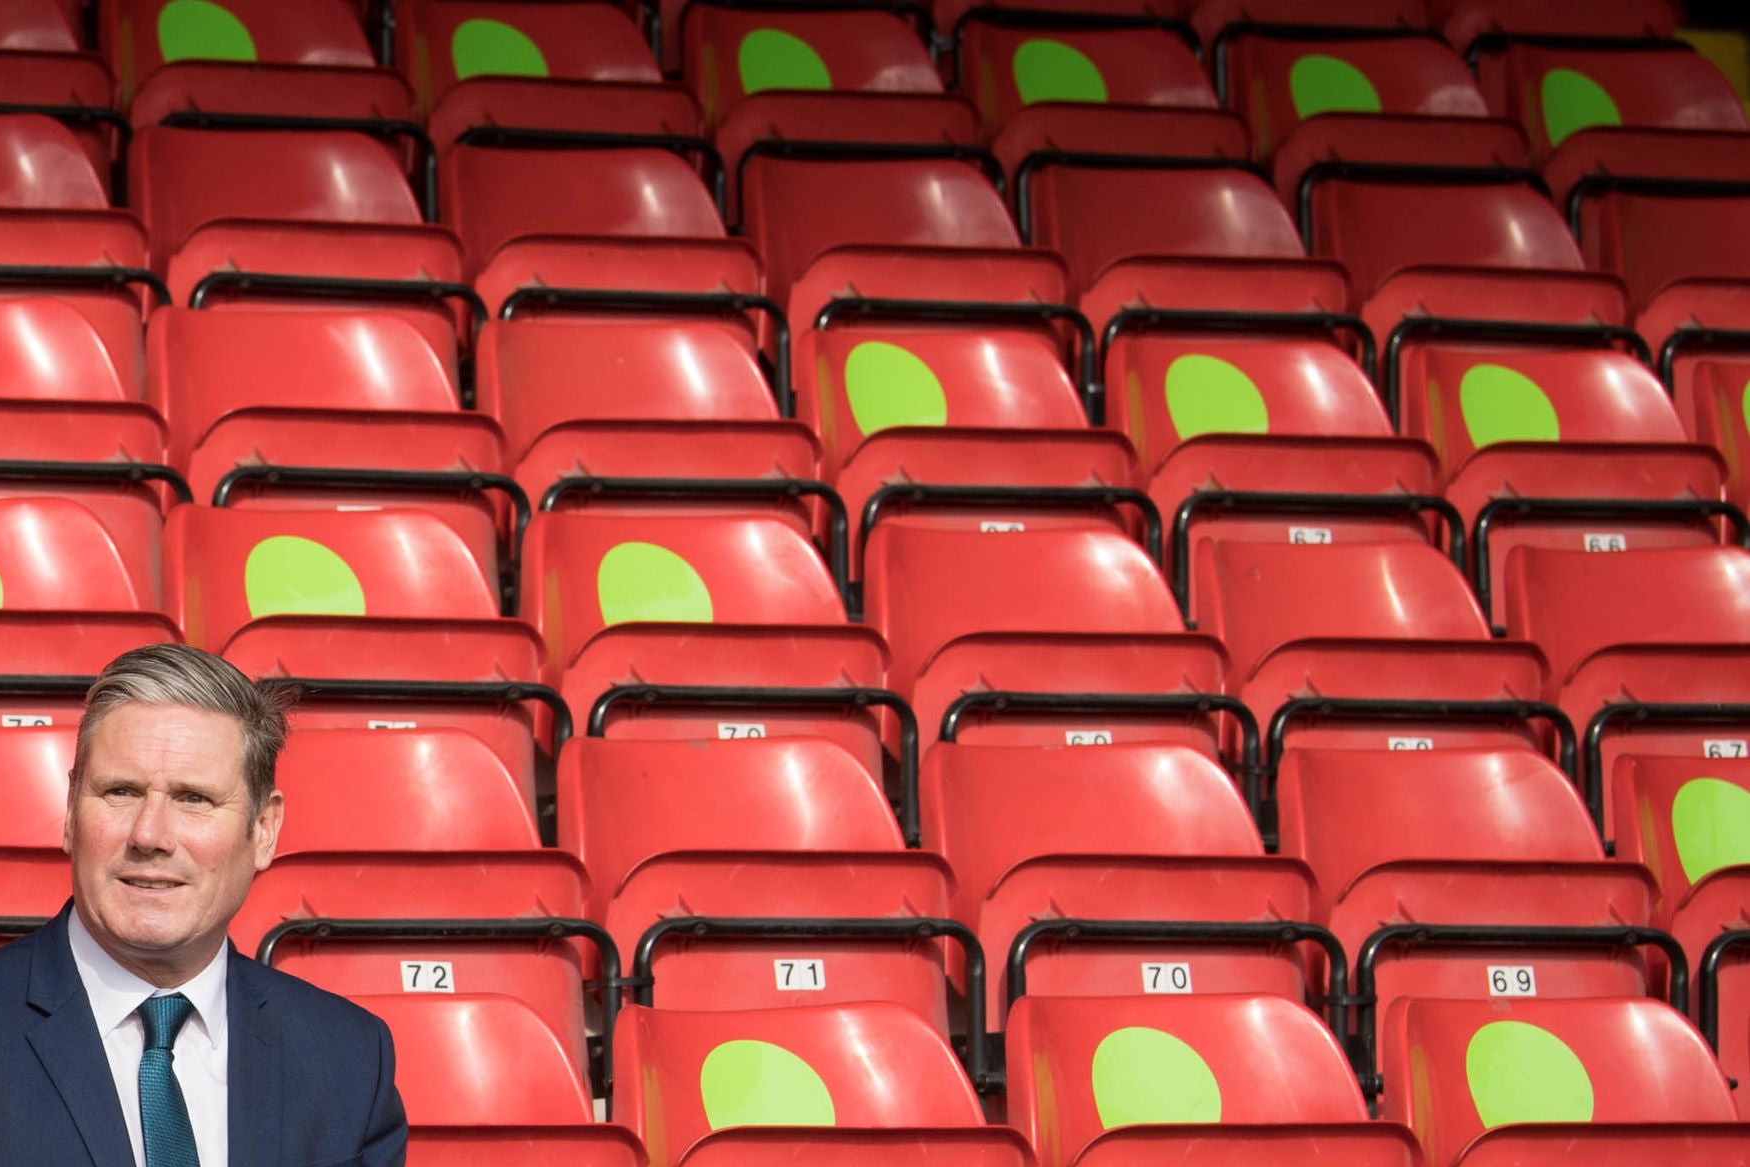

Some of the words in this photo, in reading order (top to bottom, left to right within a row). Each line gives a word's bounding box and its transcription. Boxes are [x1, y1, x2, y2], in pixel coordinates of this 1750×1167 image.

[407, 964, 448, 989] 72
[781, 963, 818, 986] 71
[1149, 966, 1187, 989] 70
[1493, 969, 1531, 993] 69
